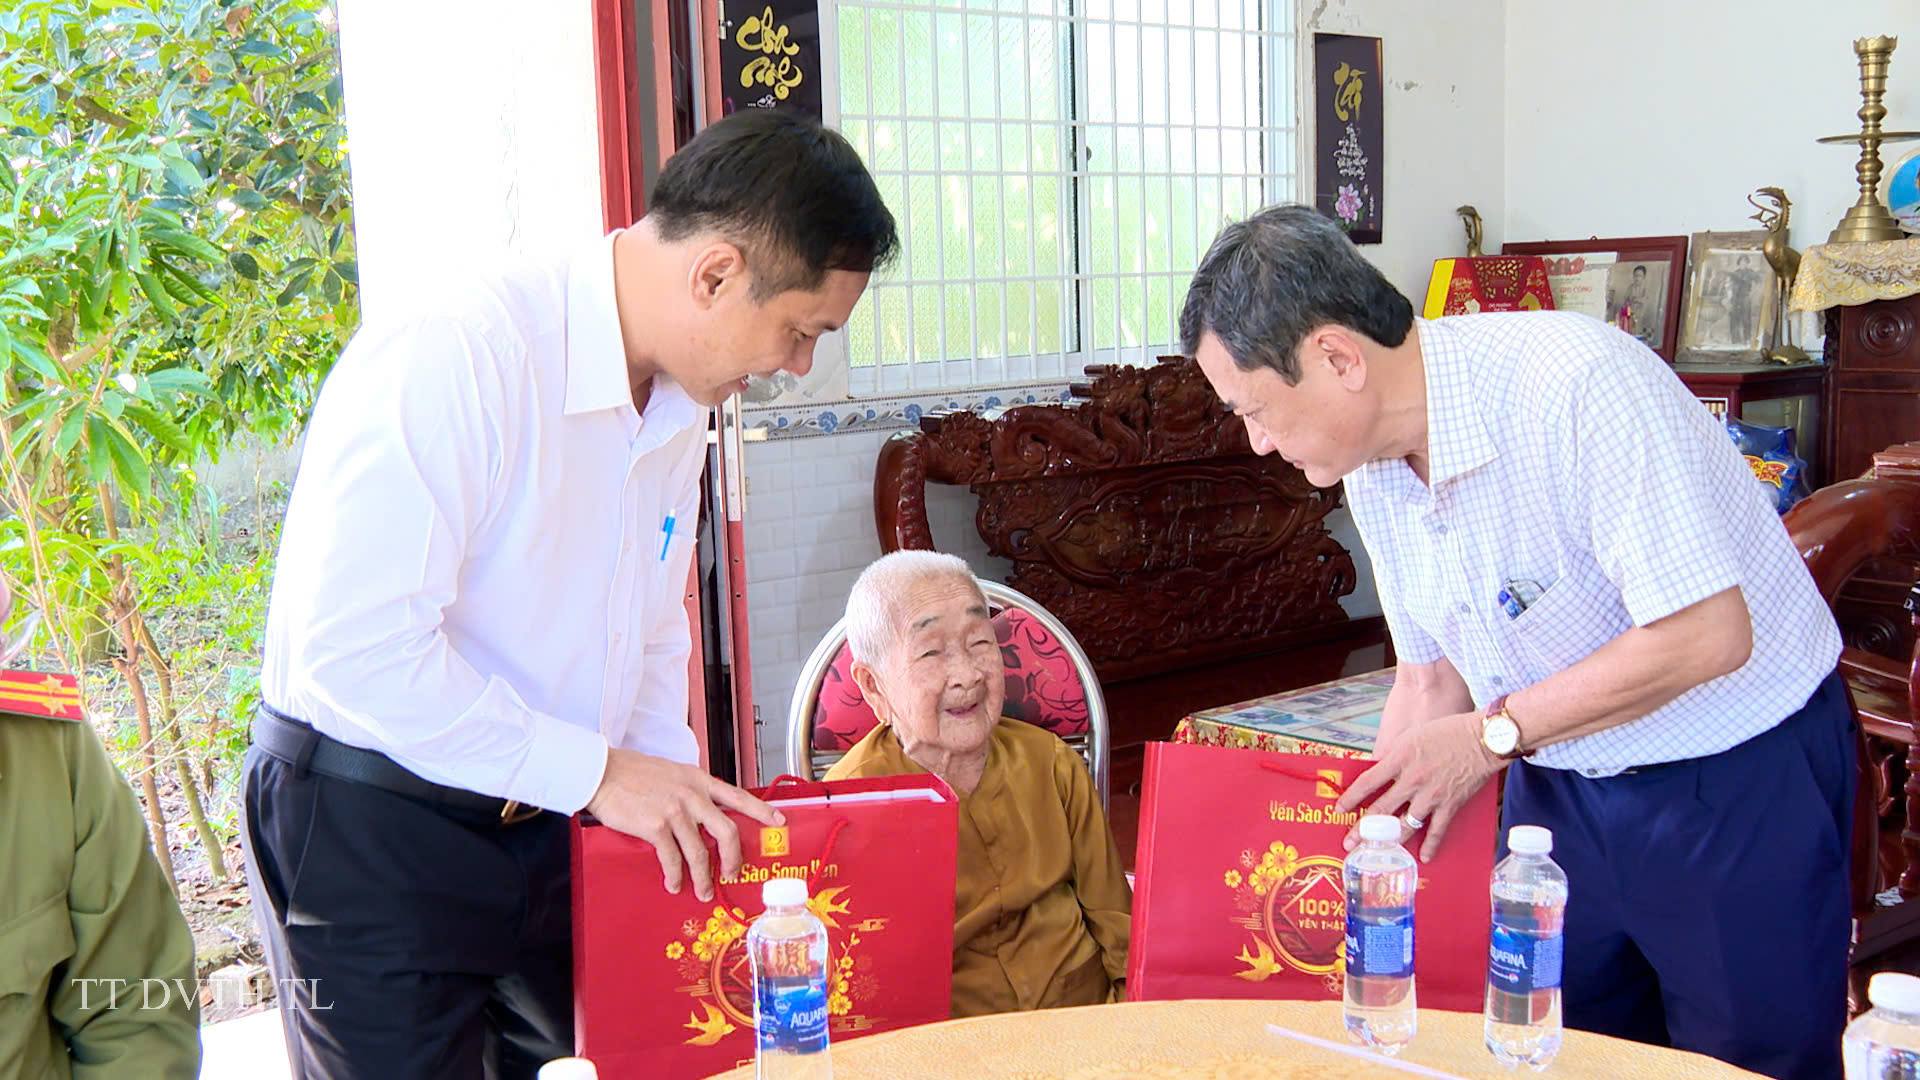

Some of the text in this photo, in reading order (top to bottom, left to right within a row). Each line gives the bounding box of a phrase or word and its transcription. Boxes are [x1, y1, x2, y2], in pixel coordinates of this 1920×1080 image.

[1269, 800, 1294, 822] Yến
[1297, 802, 1322, 824] Sào
[741, 863, 769, 883] Sào
[1299, 898, 1346, 917] 100%
